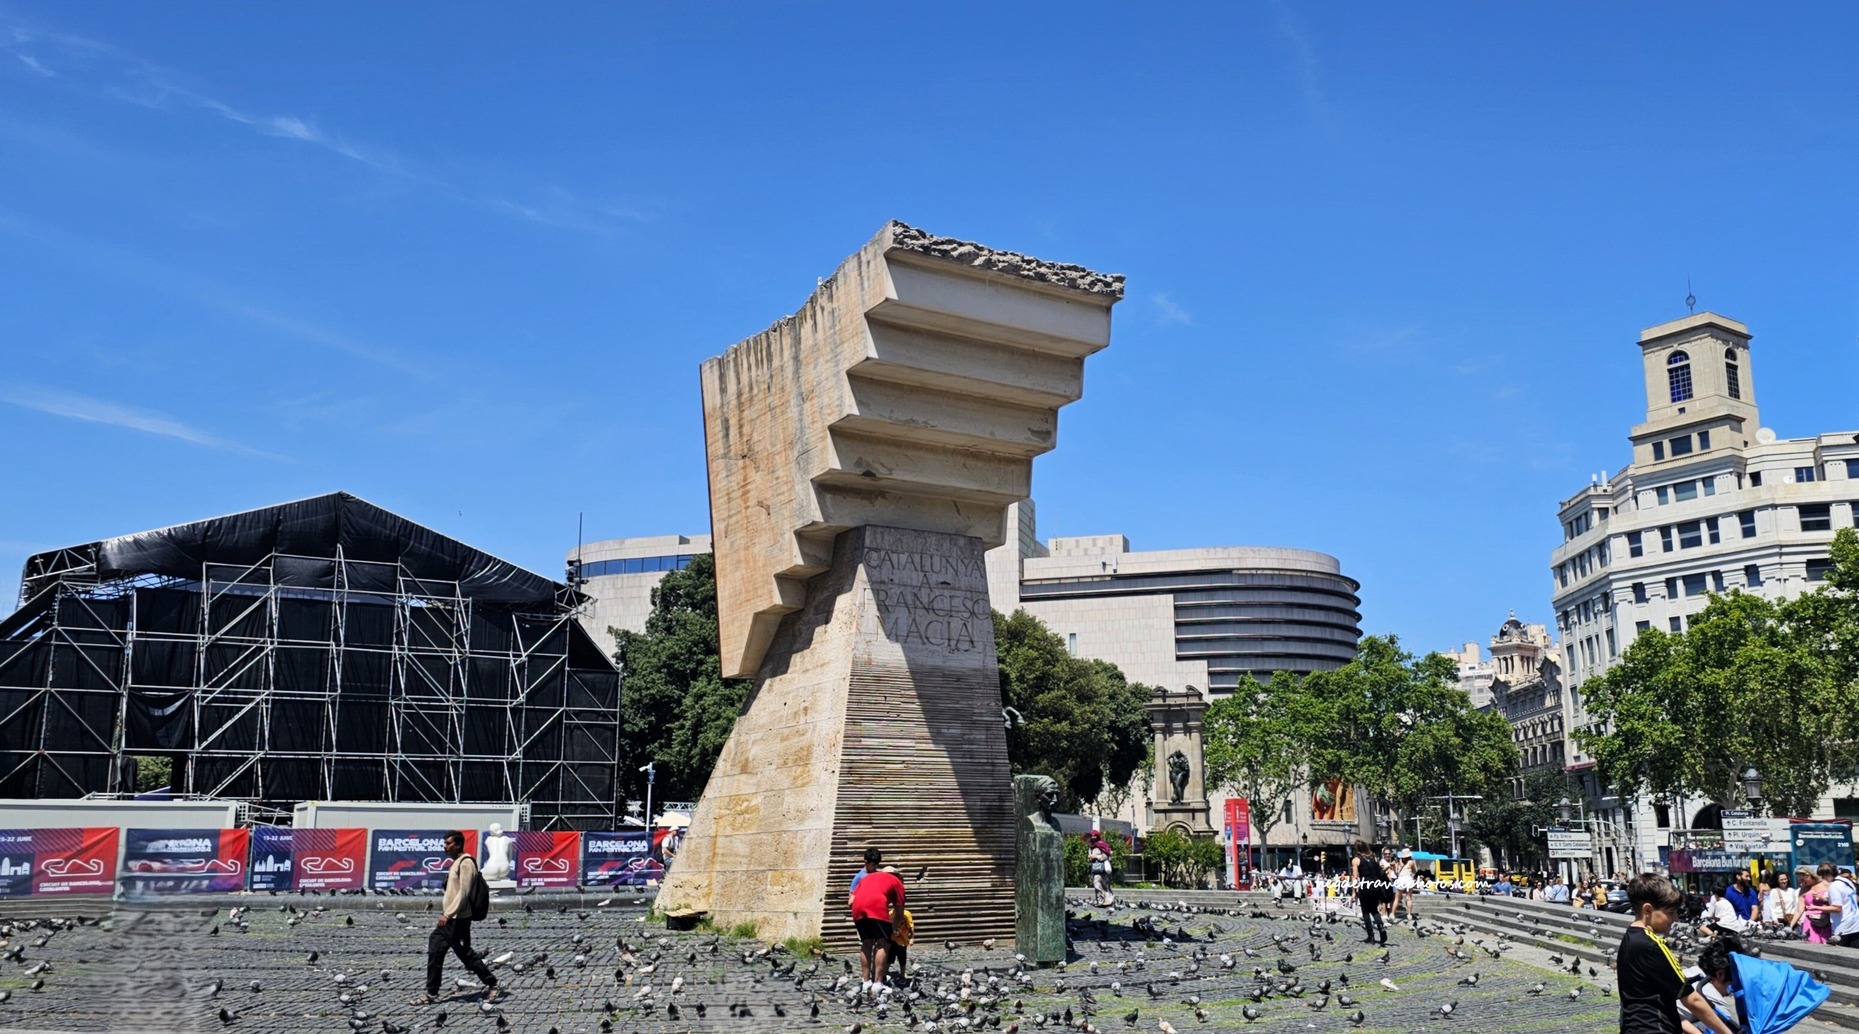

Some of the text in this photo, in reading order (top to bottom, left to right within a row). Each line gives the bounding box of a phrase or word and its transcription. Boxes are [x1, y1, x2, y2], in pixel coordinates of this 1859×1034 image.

[864, 550, 984, 578] CATALUNYA
[919, 573, 933, 592] A
[863, 587, 989, 620] FRANCESC
[378, 838, 445, 847] BARCELONA
[588, 840, 648, 848] BARCELONA
[1692, 856, 1721, 868] Barcelona
